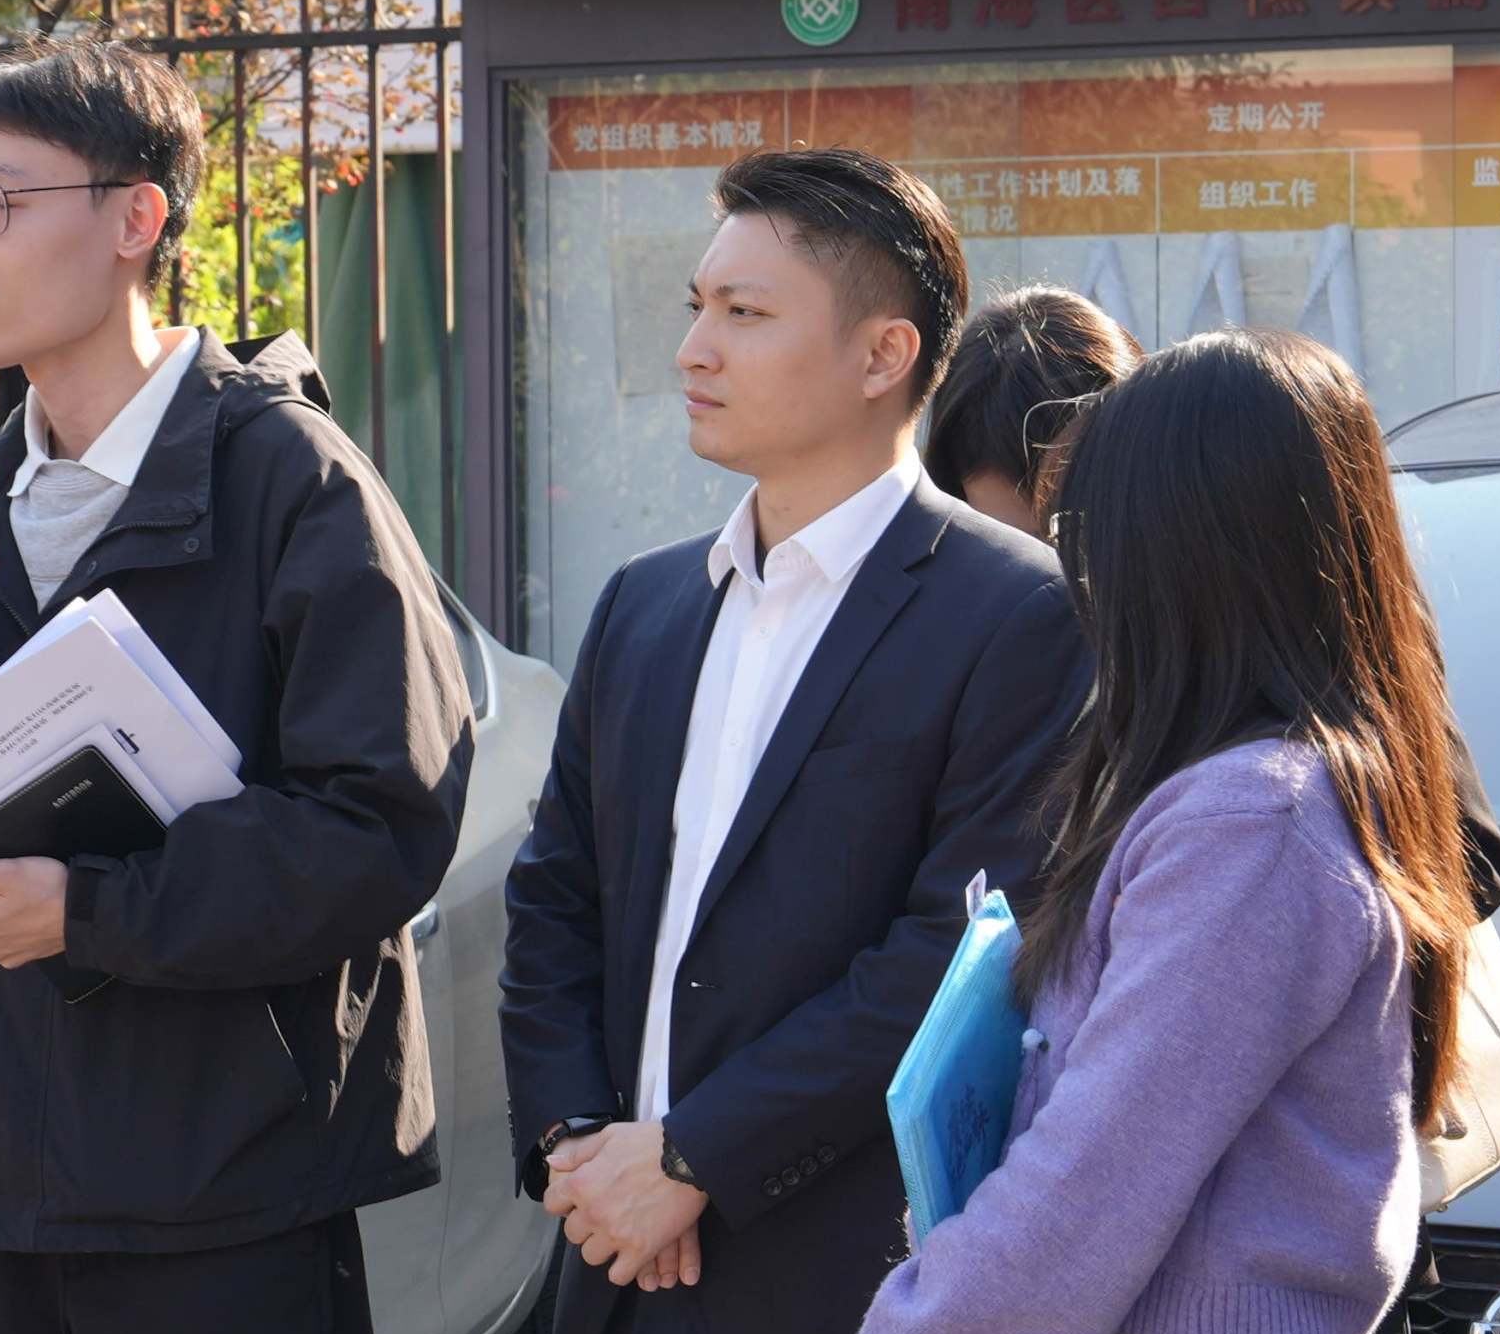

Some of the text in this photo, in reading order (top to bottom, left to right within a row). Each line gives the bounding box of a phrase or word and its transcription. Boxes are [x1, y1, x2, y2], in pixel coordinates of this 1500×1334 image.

[1207, 101, 1326, 133] 定期公开
[573, 120, 764, 153] 党组织基本情况
[1199, 178, 1318, 210] 组织工作
[950, 204, 1017, 233] 情况
